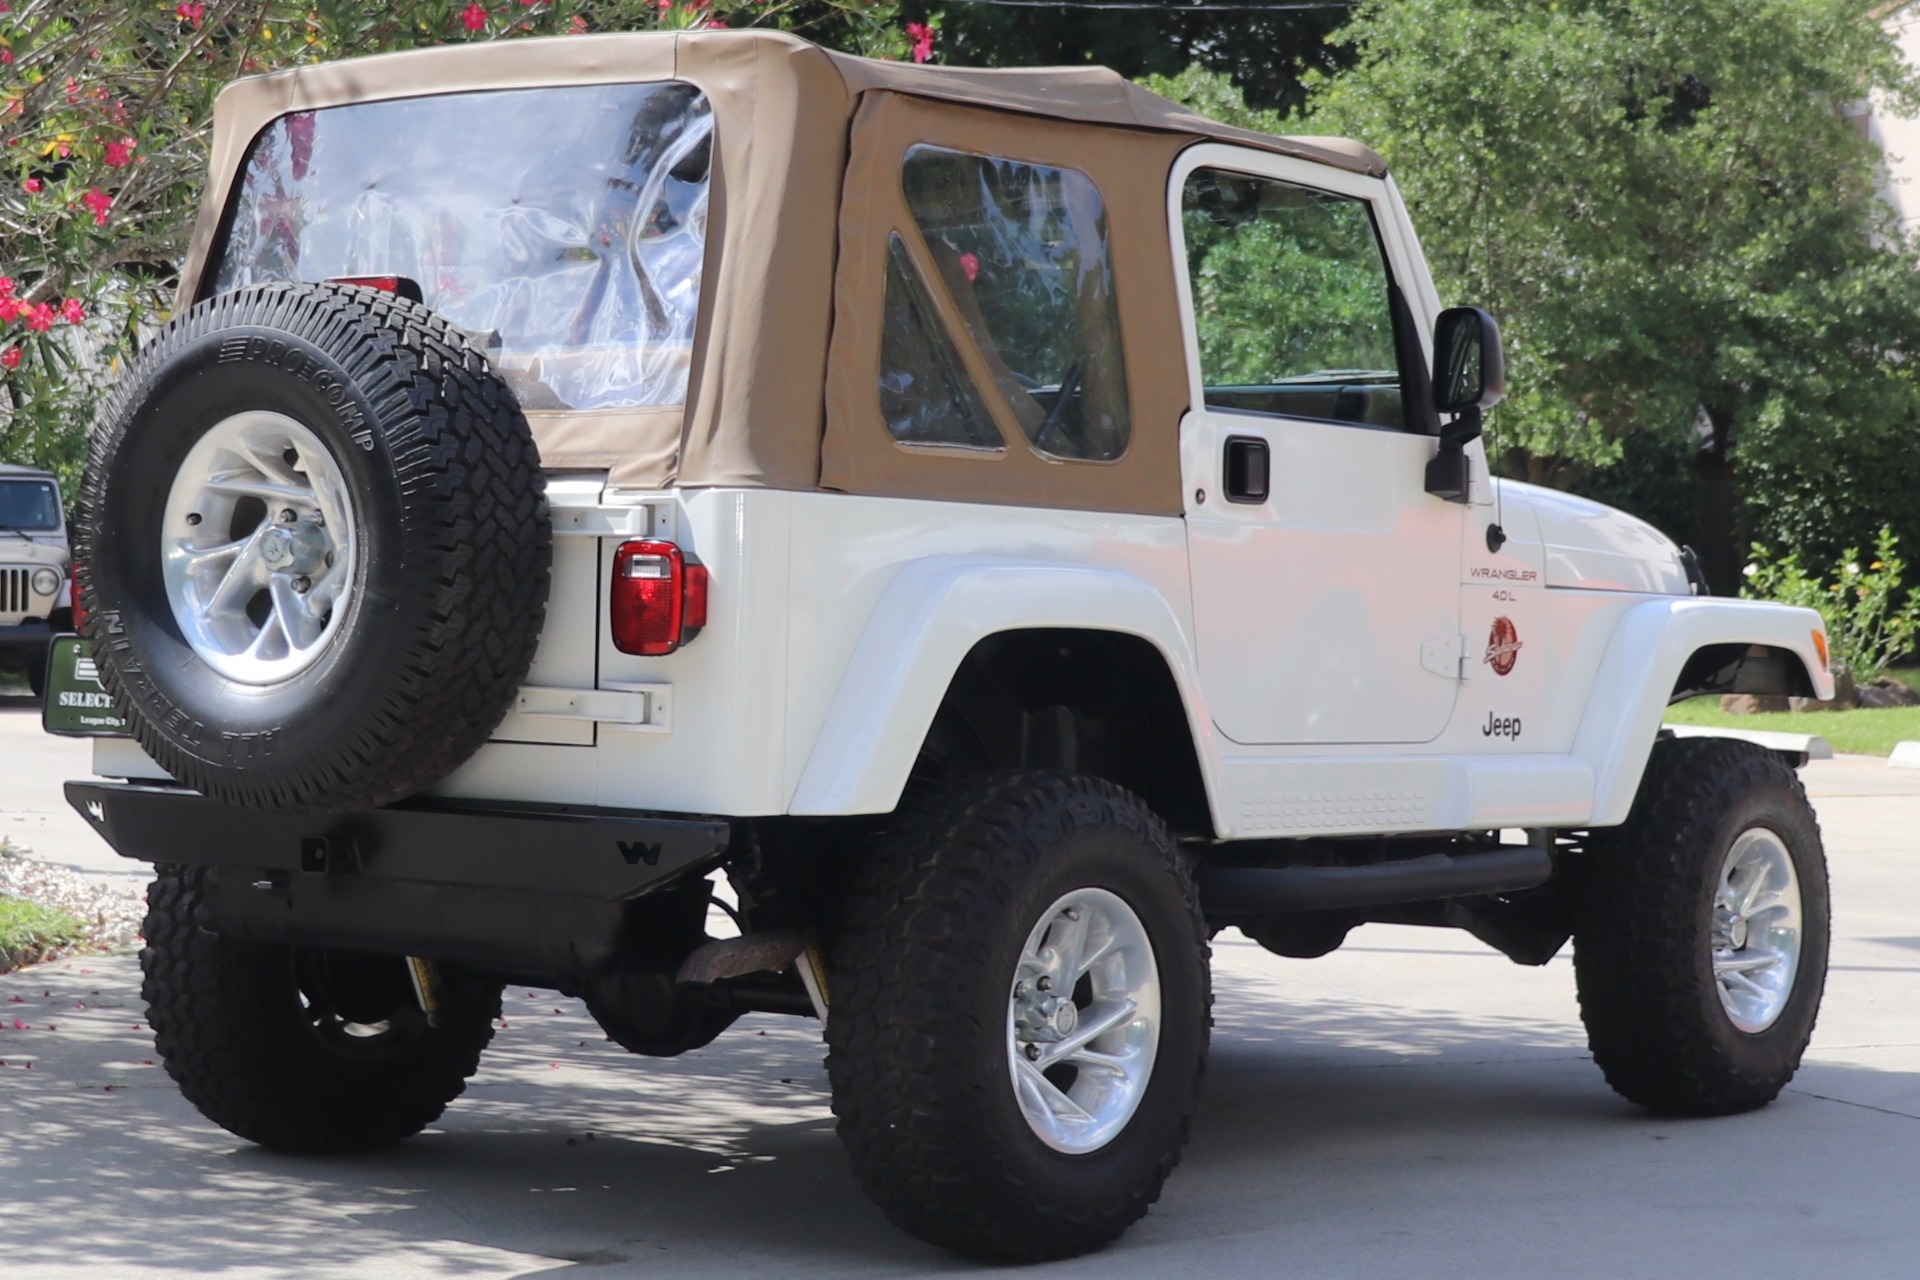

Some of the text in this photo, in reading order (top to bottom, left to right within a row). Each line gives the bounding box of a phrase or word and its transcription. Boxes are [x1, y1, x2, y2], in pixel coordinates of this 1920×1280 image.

[1470, 567, 1537, 581] WRANGLER
[59, 691, 114, 708] SELECT
[80, 715, 105, 725] League
[1482, 711, 1521, 741] Jeep
